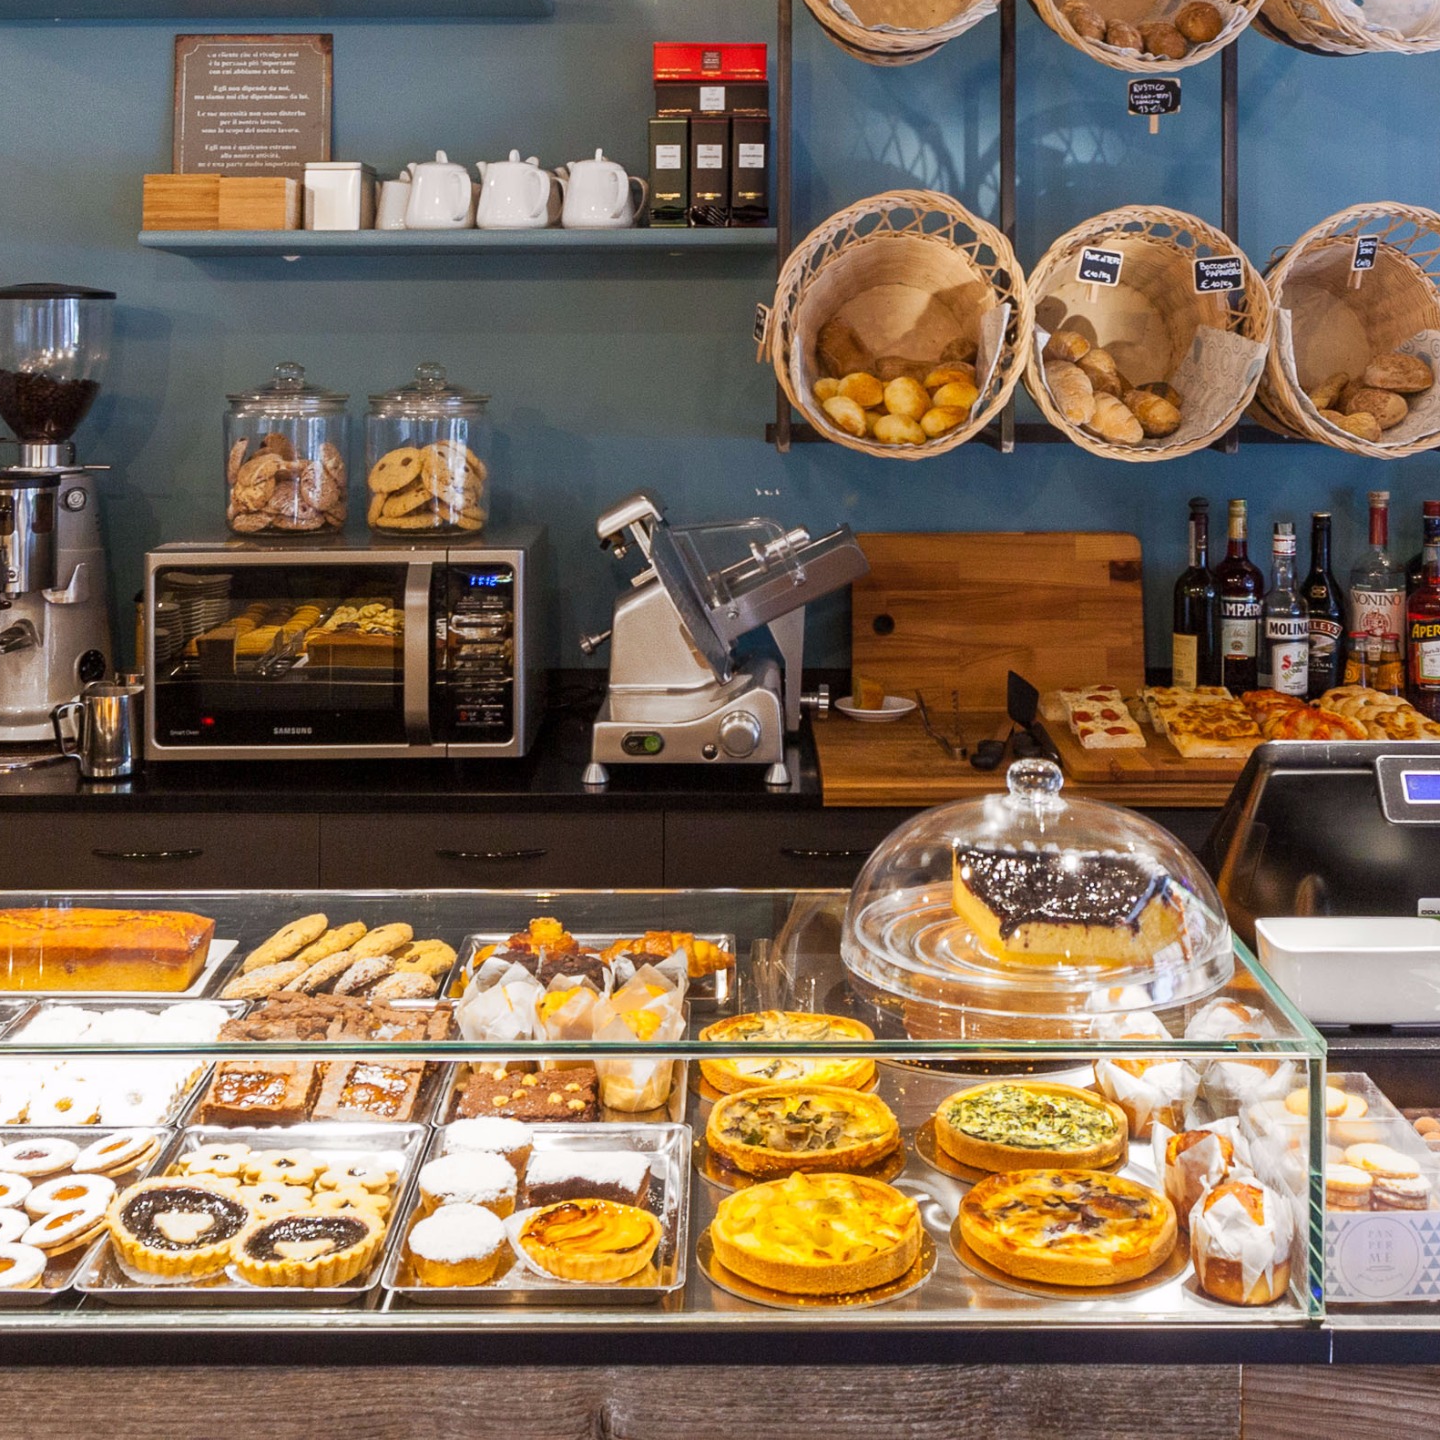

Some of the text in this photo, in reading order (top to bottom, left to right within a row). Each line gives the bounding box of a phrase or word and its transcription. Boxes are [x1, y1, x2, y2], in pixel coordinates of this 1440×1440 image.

[1133, 83, 1166, 93] RUSTICO
[1352, 593, 1403, 607] NONINO
[1222, 603, 1262, 617] MPAR
[1269, 621, 1309, 635] MOLINA
[273, 726, 313, 735] SAMSUNG
